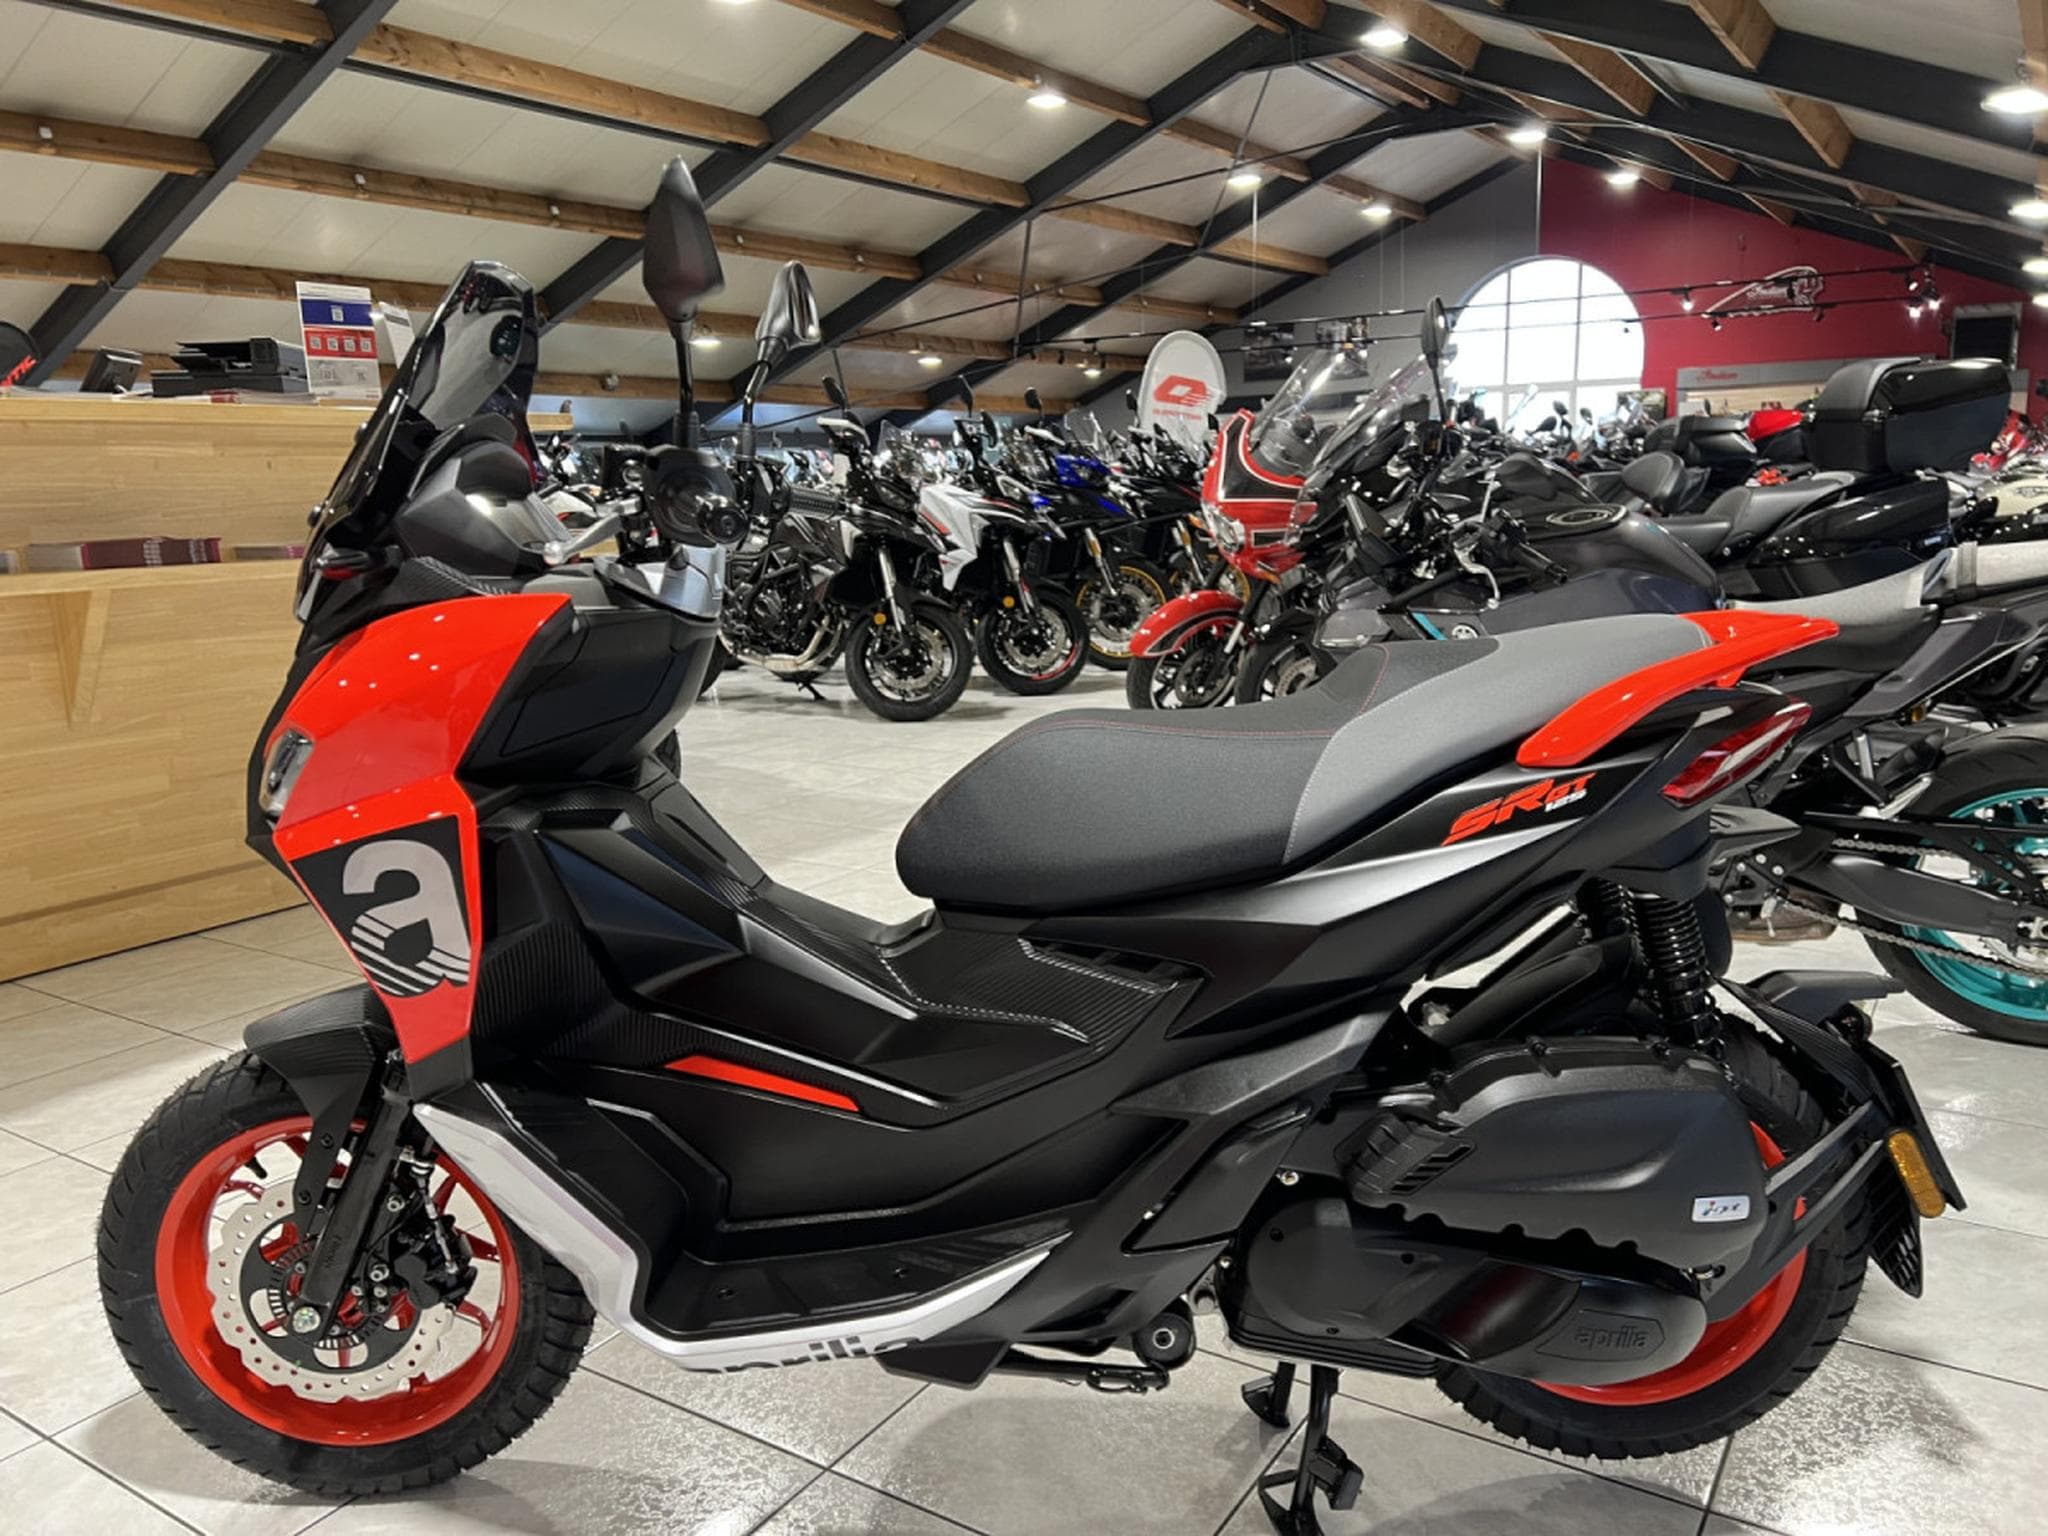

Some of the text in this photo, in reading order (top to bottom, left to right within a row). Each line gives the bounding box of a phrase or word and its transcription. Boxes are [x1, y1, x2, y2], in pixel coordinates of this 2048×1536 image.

[1440, 778, 1555, 846] SR
[342, 839, 471, 996] a
[1573, 1324, 1650, 1352] aprilia
